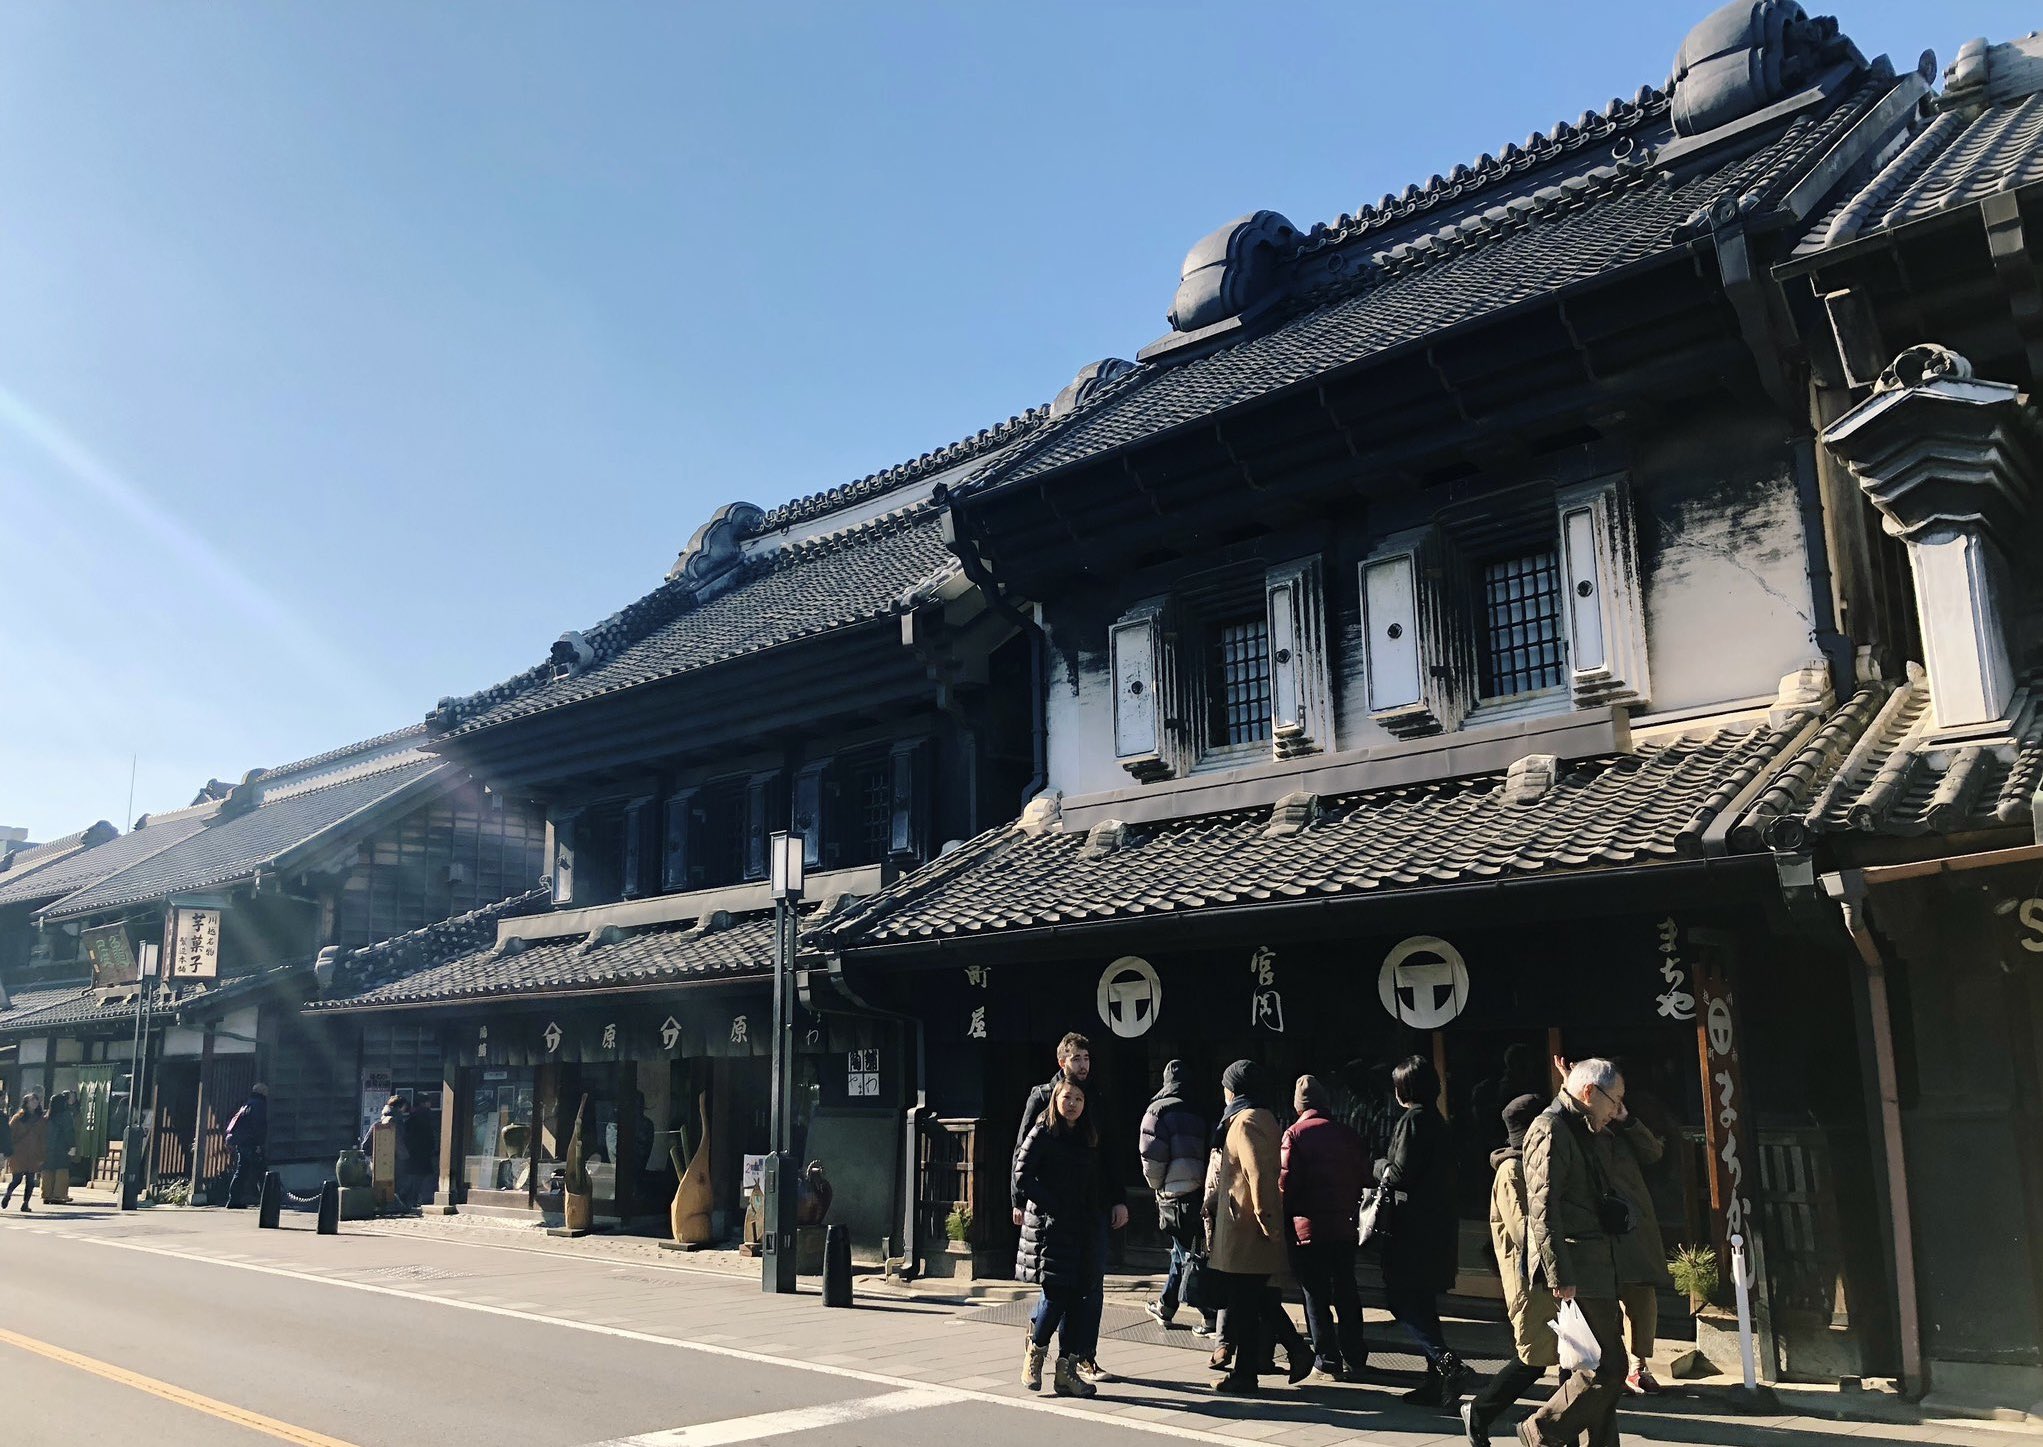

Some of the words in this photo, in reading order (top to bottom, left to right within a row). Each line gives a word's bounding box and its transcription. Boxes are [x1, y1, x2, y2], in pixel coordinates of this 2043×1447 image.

[190, 912, 206, 973] 芋菓子
[206, 915, 218, 957] 川越名物
[1251, 945, 1284, 1033] 宮岡
[1655, 916, 1697, 1020] まちや
[730, 1015, 748, 1043] 原
[964, 965, 991, 1038] 町屋
[602, 1023, 616, 1049] 原
